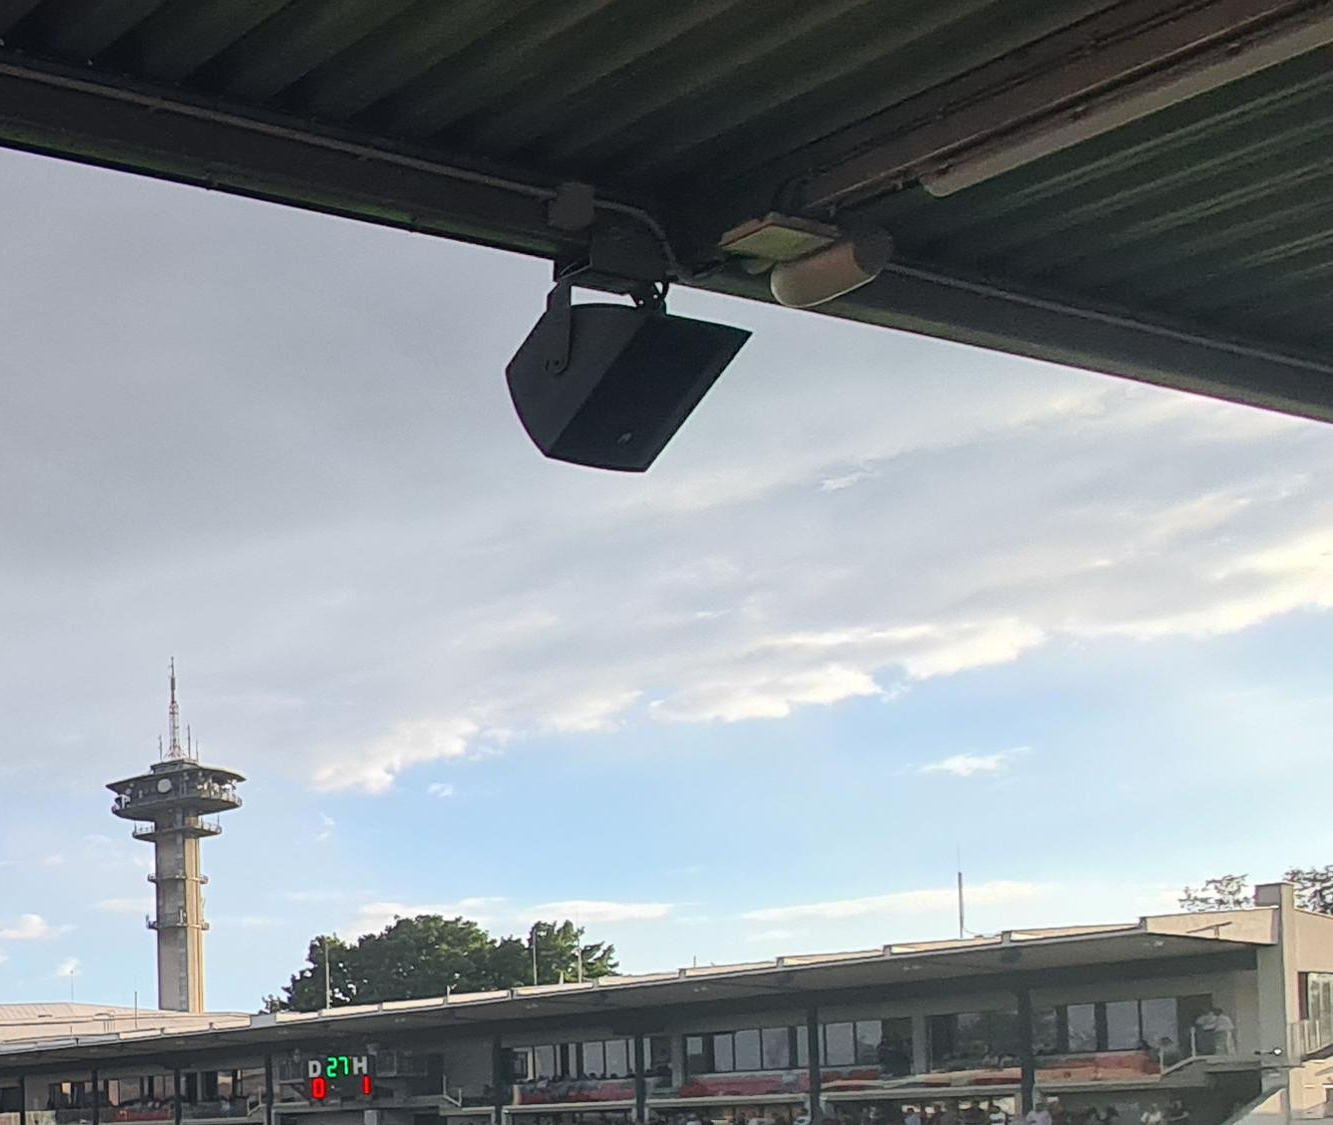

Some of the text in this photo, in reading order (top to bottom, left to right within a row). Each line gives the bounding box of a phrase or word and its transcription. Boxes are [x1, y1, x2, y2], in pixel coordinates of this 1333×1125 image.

[308, 1056, 369, 1078] D 27 H
[312, 1075, 372, 1099] 0 1
